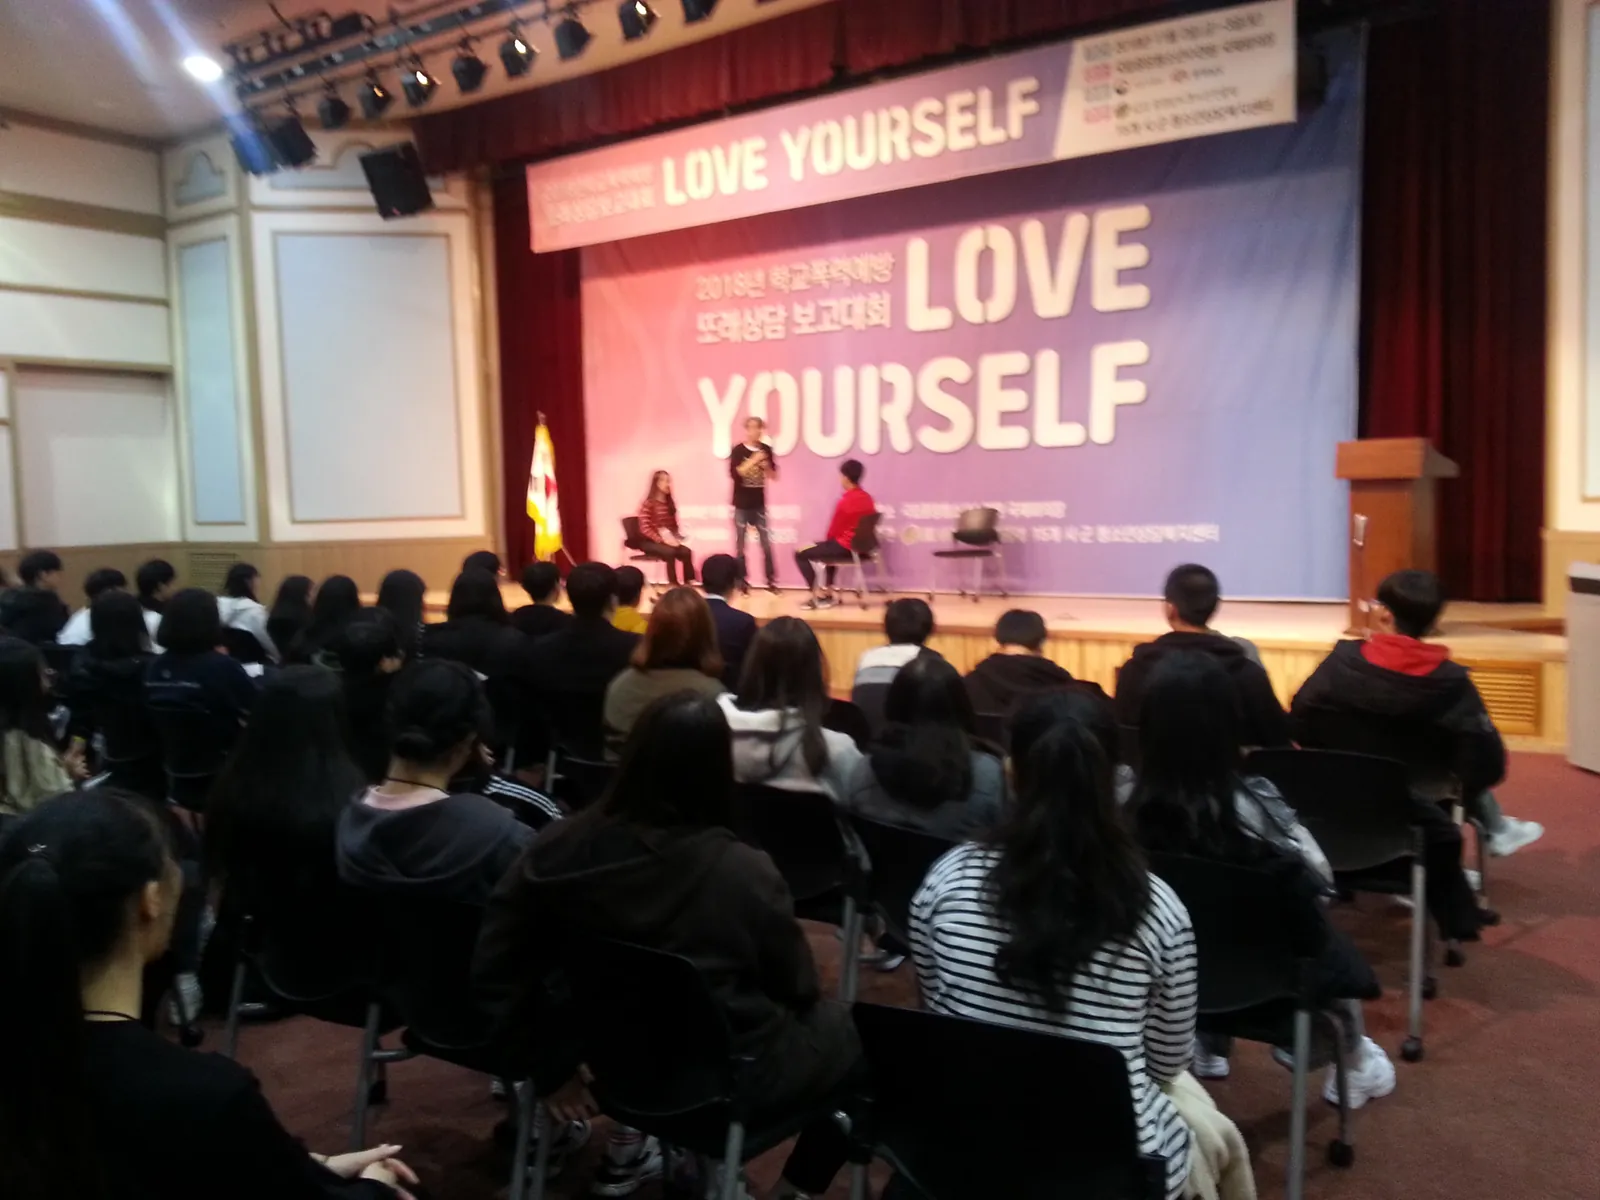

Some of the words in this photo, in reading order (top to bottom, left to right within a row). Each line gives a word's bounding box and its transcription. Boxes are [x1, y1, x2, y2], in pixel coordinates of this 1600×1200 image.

[663, 138, 768, 206] LOVE
[780, 76, 1040, 182] YOURSELF
[792, 292, 892, 335] 보고대회
[906, 205, 1151, 332] LOVE
[698, 340, 1150, 459] YOURSELF
